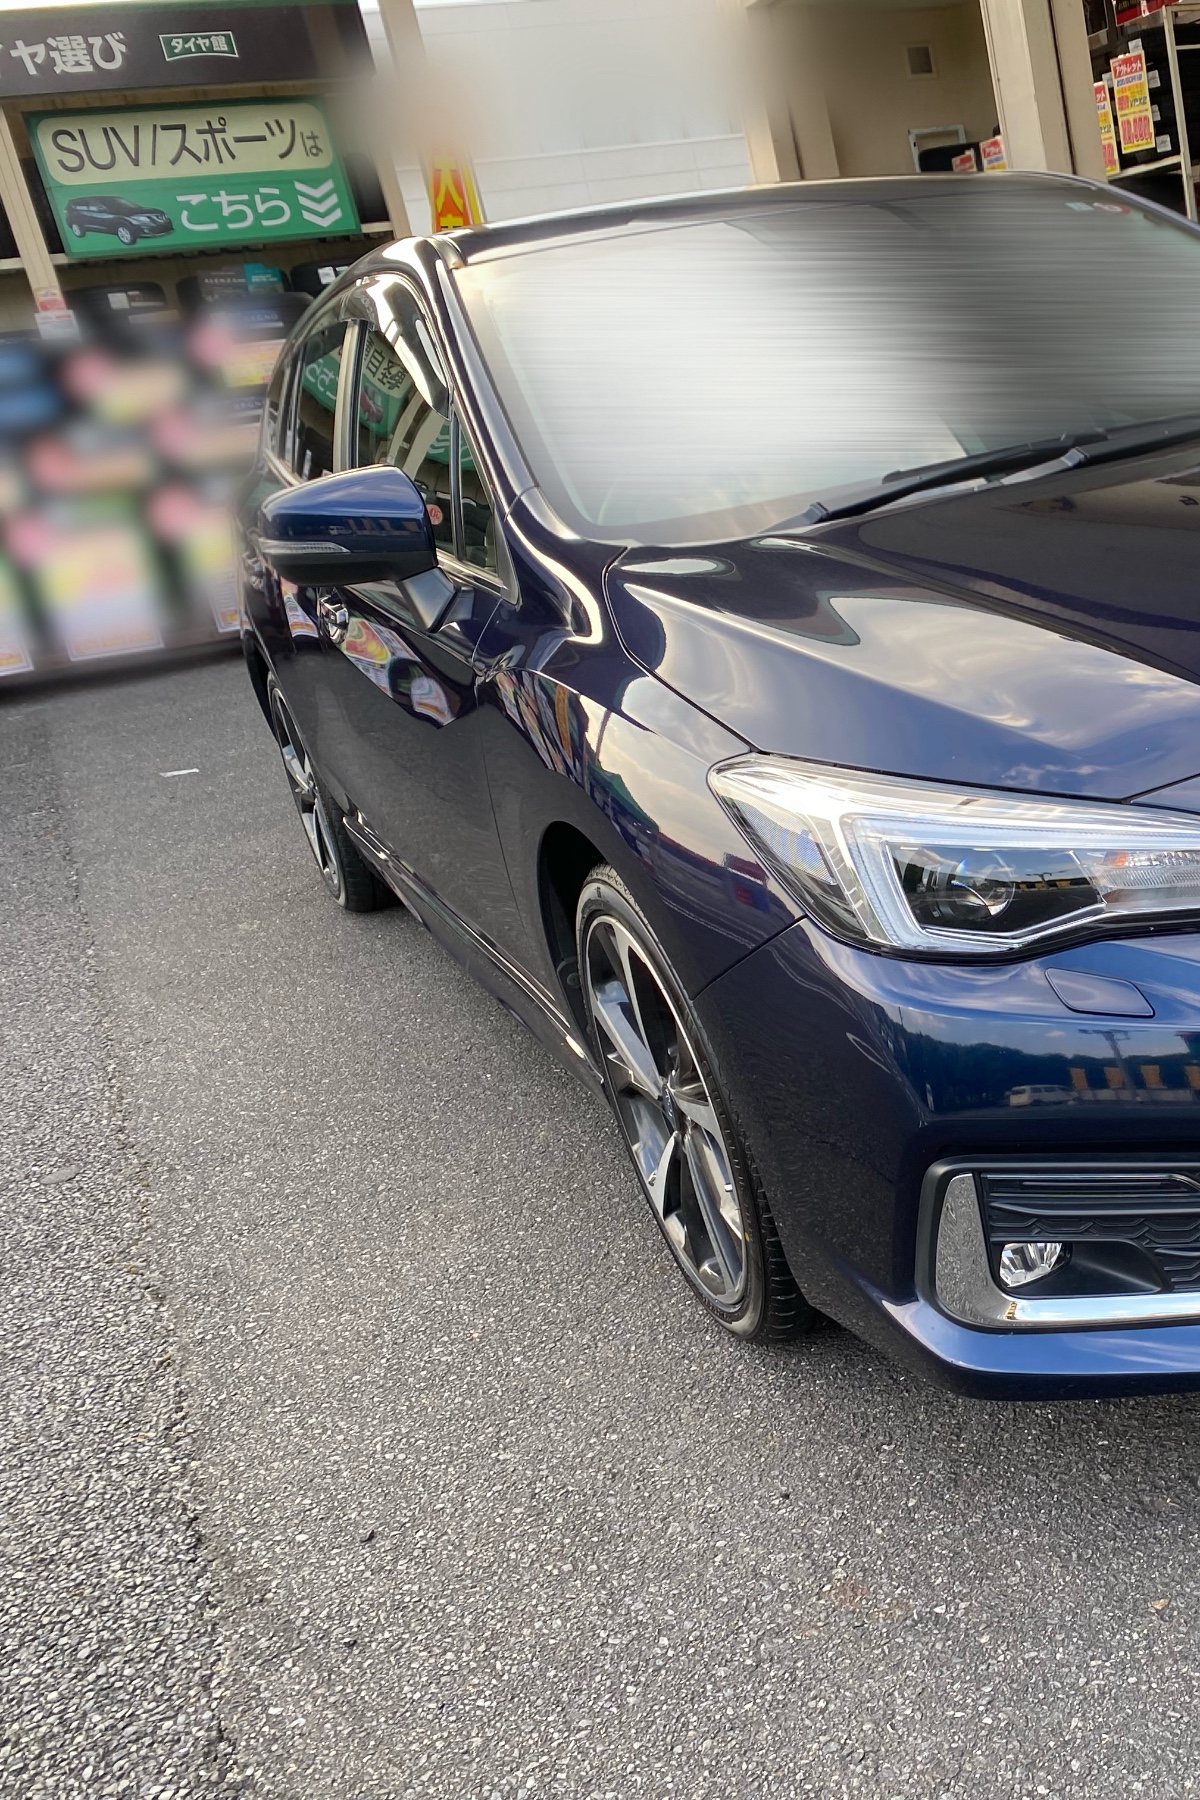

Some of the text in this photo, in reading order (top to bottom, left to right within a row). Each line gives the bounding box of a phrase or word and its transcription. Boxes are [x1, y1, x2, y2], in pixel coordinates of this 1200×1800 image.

[0, 31, 126, 76] ヤ選び
[170, 35, 228, 53] タイヤ館
[175, 187, 291, 231] こちら
